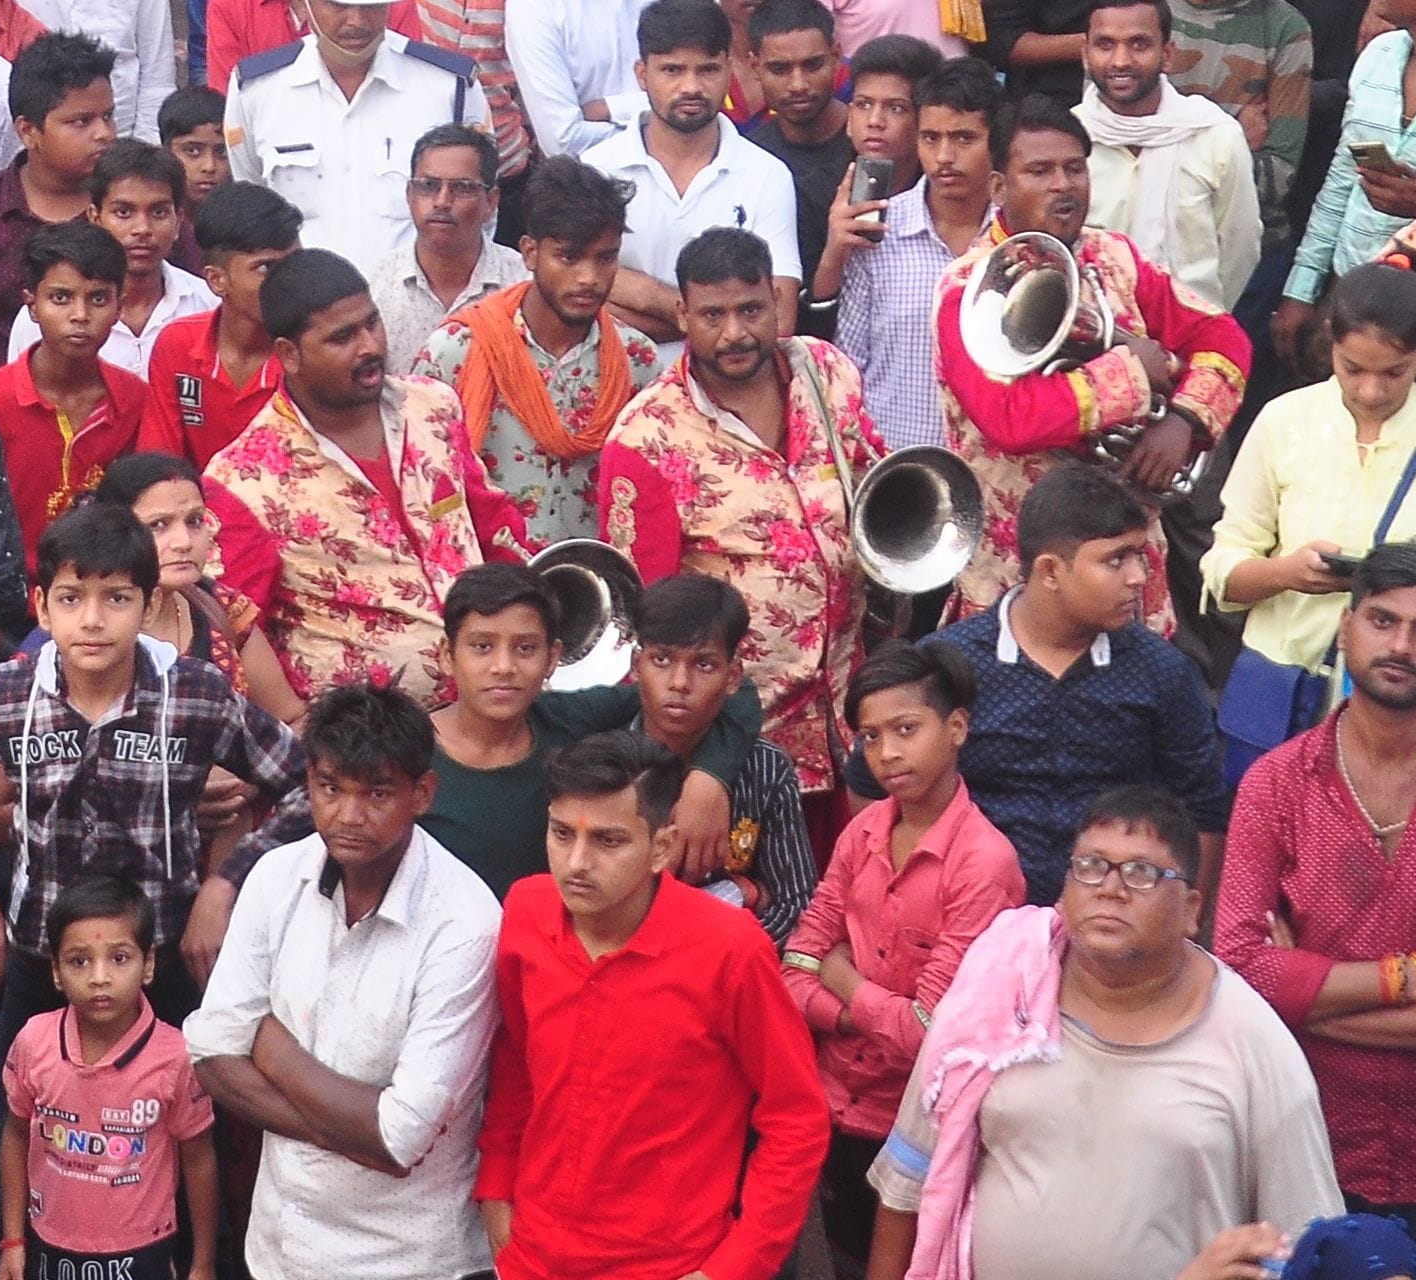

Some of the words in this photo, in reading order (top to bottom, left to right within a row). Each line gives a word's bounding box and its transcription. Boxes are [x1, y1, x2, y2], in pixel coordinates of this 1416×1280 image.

[9, 730, 83, 765] ROCK
[114, 729, 187, 764] TEAM
[130, 1098, 161, 1125] 89
[39, 1120, 145, 1159] LONDON
